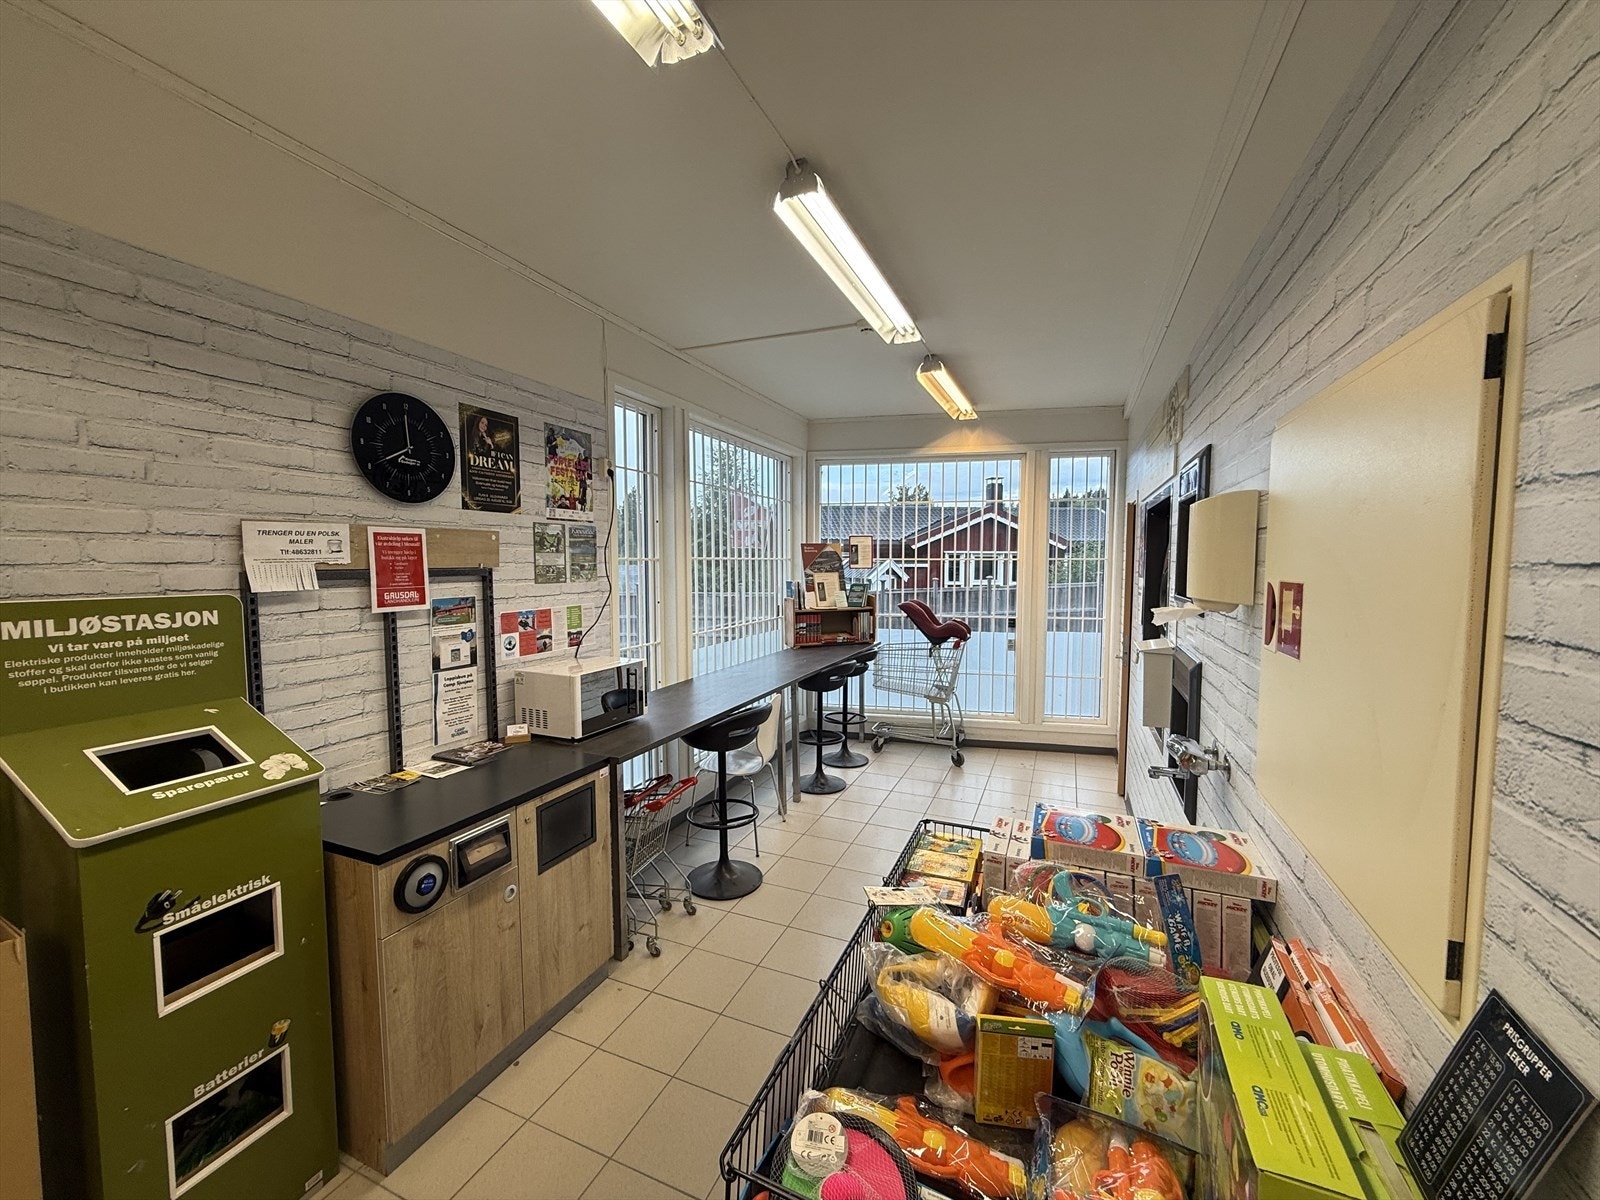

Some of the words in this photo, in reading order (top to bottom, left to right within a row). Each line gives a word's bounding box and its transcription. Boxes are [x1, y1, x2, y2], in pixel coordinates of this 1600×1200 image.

[470, 455, 515, 471] DREAM
[384, 591, 419, 600] GAUSDAL
[1, 610, 219, 640] MILJØSTASJON
[5, 657, 61, 668] Elektriske
[63, 651, 113, 665] produkter
[115, 647, 164, 658] inneholder
[166, 641, 224, 655] miljøskadelige
[48, 643, 63, 653] Vi
[67, 642, 88, 652] tar
[92, 640, 122, 650] vare
[127, 635, 144, 648] på
[147, 633, 189, 647] miljøet
[9, 667, 46, 679] stoffer
[49, 667, 63, 677] og
[65, 662, 87, 673] skal
[89, 659, 119, 670] derfor
[122, 657, 141, 667] ikke
[144, 655, 173, 665] kastes
[176, 653, 193, 661] som
[195, 650, 219, 660] vanlig
[19, 675, 59, 690] søppel.
[62, 669, 112, 682] Produkter
[114, 664, 164, 677] tilsvarende
[166, 662, 177, 671] de
[180, 661, 187, 669] vi
[189, 658, 213, 669] selger
[50, 681, 96, 693] butikken
[99, 677, 117, 687] kan
[120, 674, 152, 685] leveres
[155, 670, 179, 683] gratis
[181, 668, 197, 677] her.
[151, 767, 250, 801] Sparepærer
[162, 873, 271, 926] Småelektrisk
[1226, 905, 1248, 913] MICKEY
[1168, 919, 1183, 954] GAME
[1174, 913, 1192, 947] WATER
[1489, 1053, 1502, 1071] 15.90
[1503, 1023, 1552, 1081] PRISGRUPPER
[1507, 1047, 1529, 1076] LEKER
[192, 1047, 265, 1099] Batterier
[1122, 1051, 1135, 1098] Winnie
[1477, 1070, 1490, 1088] 24.90
[1483, 1062, 1496, 1080] 19.90
[1466, 1087, 1479, 1105] 34.90
[1471, 1078, 1485, 1097] 29.90
[1428, 1107, 1434, 1116] 12
[1433, 1098, 1439, 1108] 11
[1506, 1093, 1514, 1104] 18
[1514, 1103, 1522, 1115] Kr.
[1522, 1113, 1542, 1139] 129.00
[1512, 1083, 1521, 1093] 17
[1520, 1095, 1528, 1106] Kr.
[1529, 1105, 1549, 1130] 119.00
[1418, 1122, 1424, 1131] 14
[1493, 1110, 1502, 1121] 20
[1510, 1131, 1529, 1157] 159.00
[1500, 1102, 1508, 1111] 19
[1516, 1123, 1535, 1148] 149.00
[1482, 1127, 1490, 1139] 22
[1498, 1149, 1516, 1175] 179.00
[1487, 1119, 1496, 1129] 21
[1503, 1141, 1522, 1166] 169.00
[1454, 1170, 1463, 1179] 27
[1459, 1161, 1467, 1173] 26
[1470, 1144, 1479, 1155] 24
[1486, 1167, 1503, 1193] 199.00
[1476, 1136, 1484, 1147] 23
[1492, 1158, 1510, 1184] 189.00
[1444, 1186, 1452, 1196] 29
[1449, 1178, 1457, 1190] 28
[1465, 1153, 1473, 1164] 25
[1479, 1175, 1497, 1200] 209.00
